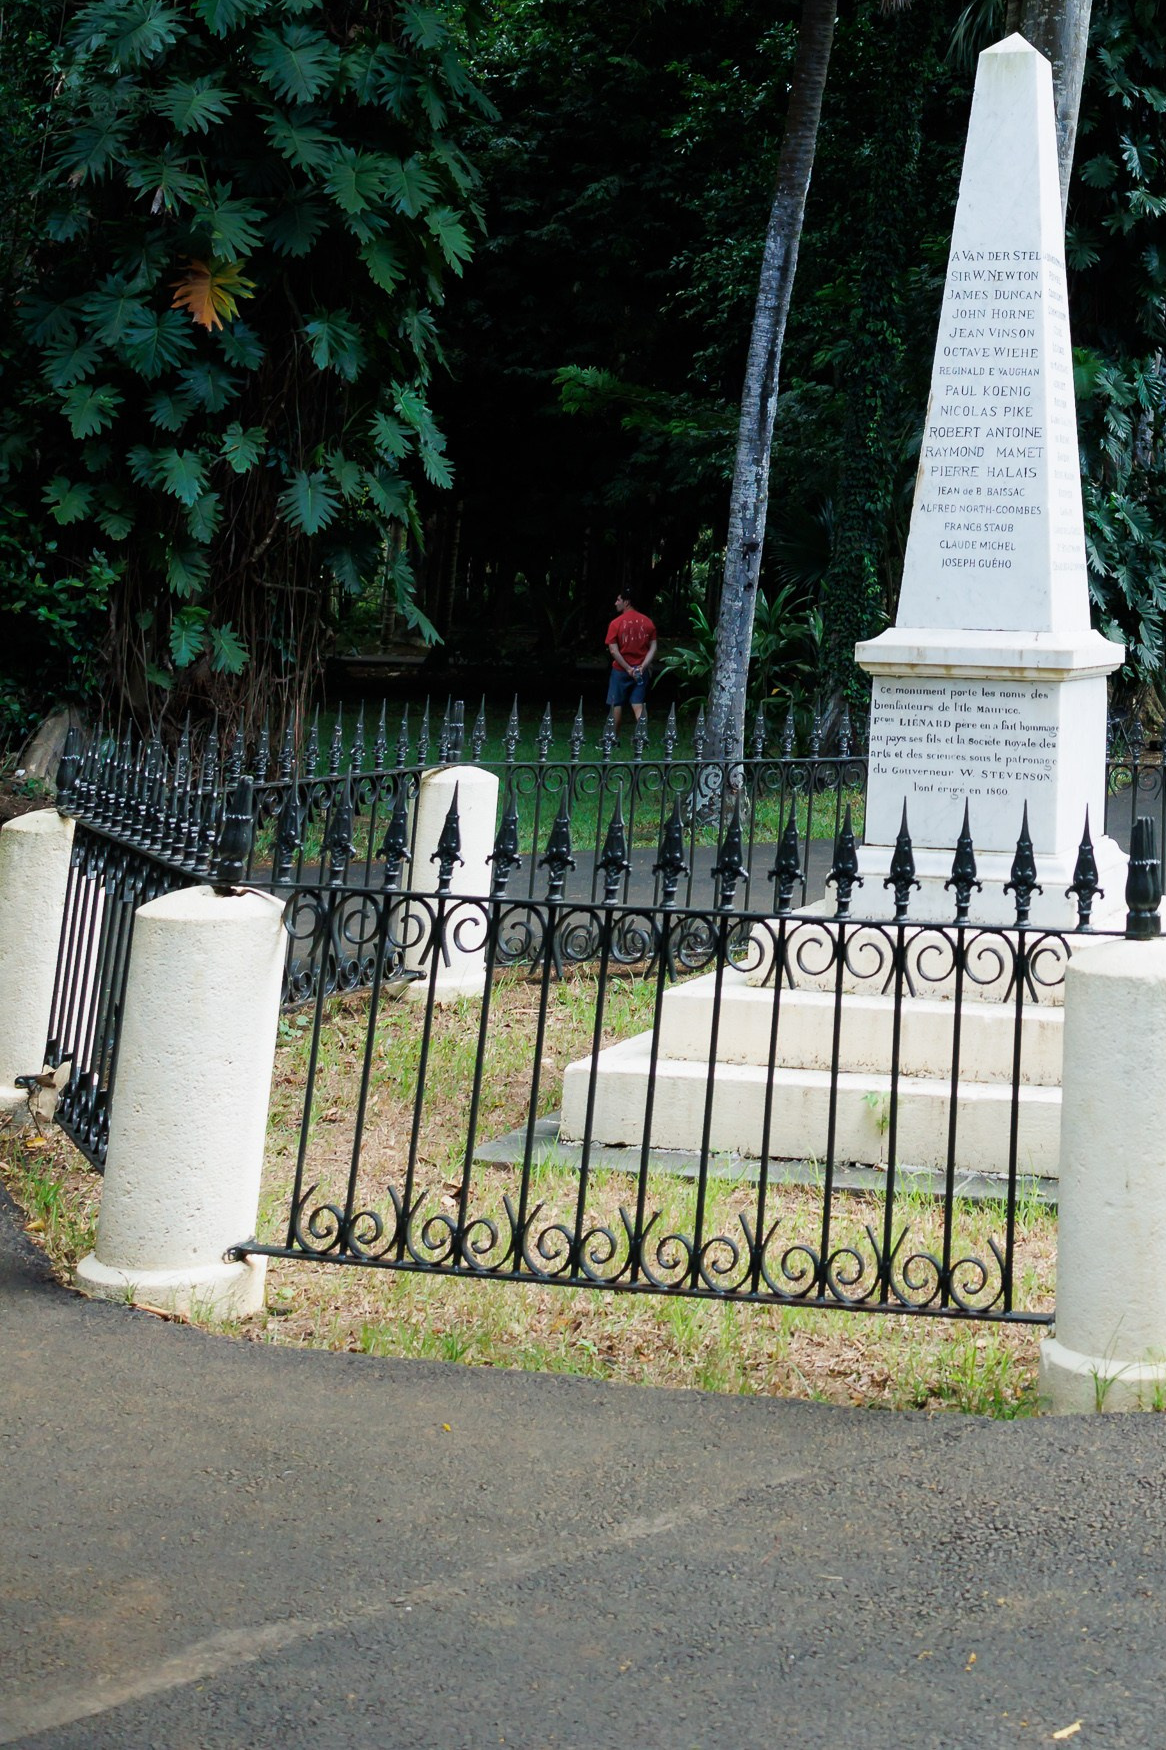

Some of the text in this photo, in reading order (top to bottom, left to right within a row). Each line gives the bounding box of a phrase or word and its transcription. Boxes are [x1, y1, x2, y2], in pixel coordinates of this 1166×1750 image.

[951, 251, 960, 262] A
[988, 251, 1010, 261] DER
[952, 309, 1035, 319] JOHN HORNE
[949, 327, 1035, 339] JEAN VINSON
[943, 346, 1039, 358] OCTAVE WIEHE
[939, 366, 985, 376] REGINALD
[945, 384, 1031, 397] PAUL KOENIG
[940, 405, 1033, 418] NICOLAS PIKE
[929, 426, 1043, 439] ROBERT ANTOINE
[925, 446, 985, 458] RAYMOND
[996, 446, 1045, 458] MAMET
[930, 466, 1037, 478] PIERRE HALAIS
[938, 486, 960, 496] JEAN
[962, 488, 974, 496] de
[986, 487, 1026, 497] BAISSAC
[920, 503, 1042, 515] ALFRED NORTH-COOMBES
[984, 523, 1014, 533] STAUB
[939, 540, 1016, 551] CLAUDE MICHEL
[941, 557, 1012, 569] JOSEPH GUÉHO
[895, 688, 946, 696] monument
[950, 688, 978, 700] porte
[981, 687, 996, 698] les
[1030, 688, 1049, 699] des
[937, 702, 950, 712] de
[871, 734, 883, 742] au
[885, 735, 907, 747] pays
[926, 733, 942, 744] fils
[945, 736, 954, 745] et
[956, 734, 965, 745] la
[1038, 738, 1057, 749] des
[870, 749, 891, 758] arts
[894, 750, 903, 759] et
[906, 748, 923, 759] des
[926, 753, 967, 761] sciences
[969, 754, 991, 762] sous
[994, 752, 1003, 763] le
[873, 763, 888, 774] du
[891, 766, 954, 777] Gouverneur
[969, 787, 981, 795] en
